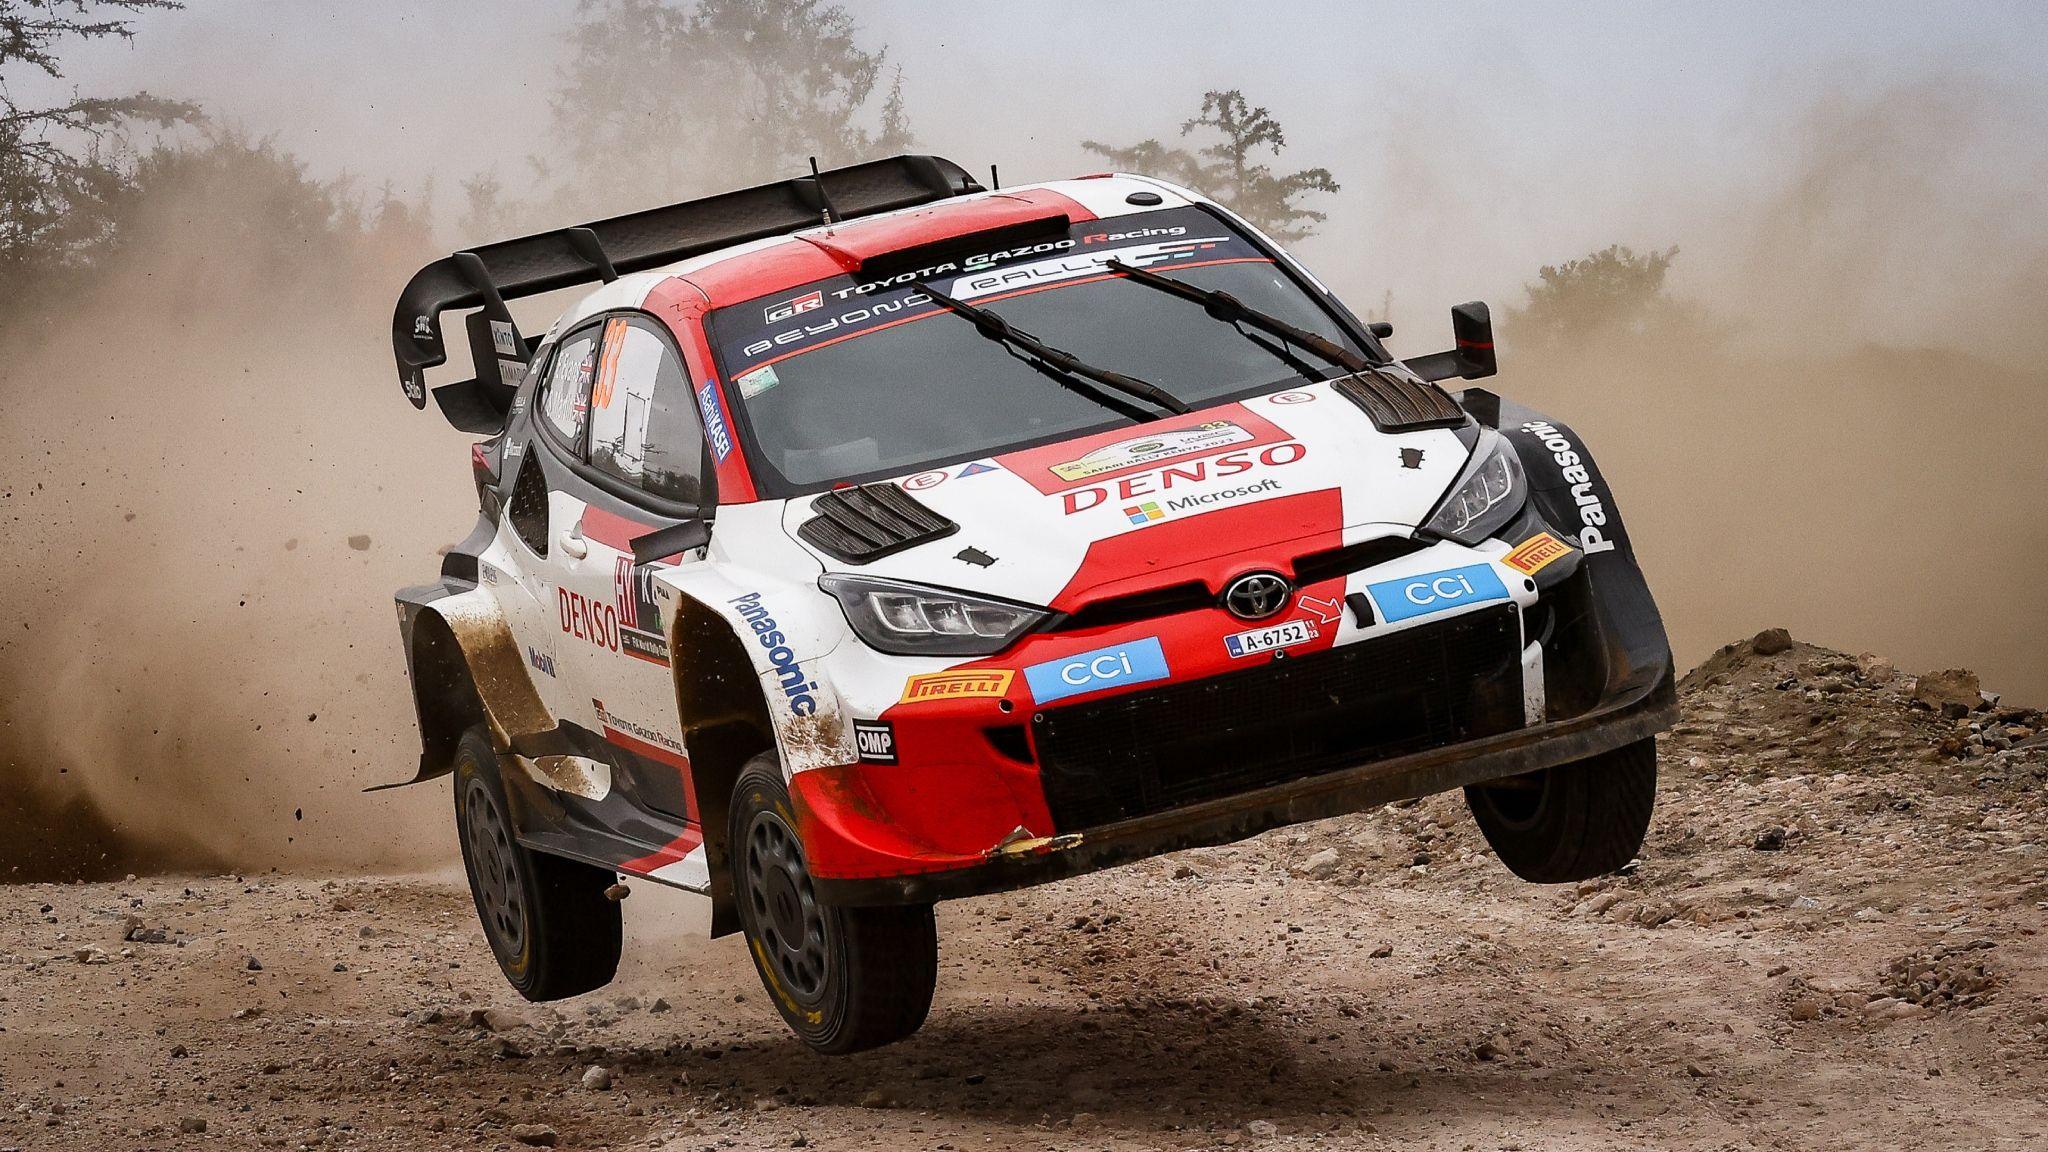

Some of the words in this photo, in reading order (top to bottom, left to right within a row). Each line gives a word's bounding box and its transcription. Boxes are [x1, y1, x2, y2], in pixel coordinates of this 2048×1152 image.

[832, 261, 957, 299] TOYOTA
[965, 239, 1076, 266] GAZOO
[1084, 226, 1187, 245] Racing
[743, 293, 933, 356] BEYOND
[971, 253, 1121, 290] RALLY
[592, 318, 627, 409] 33
[1061, 443, 1307, 516] DENSO
[1083, 462, 1125, 475] SAFARI
[1126, 453, 1160, 465] RALLY
[1163, 445, 1202, 457] KENYA
[1167, 478, 1282, 512] Microsoft
[1521, 421, 1616, 555] Panasonic
[1509, 537, 1562, 571] PIRELLI
[558, 586, 618, 653] DENSO
[1246, 626, 1304, 651] A-6752
[727, 592, 817, 717] Panasonic
[908, 674, 1004, 698] PIRELLI
[606, 711, 634, 734] TOYOTA
[632, 723, 658, 742] GAZOO
[656, 732, 683, 754] Racing
[858, 732, 892, 754] OMP
